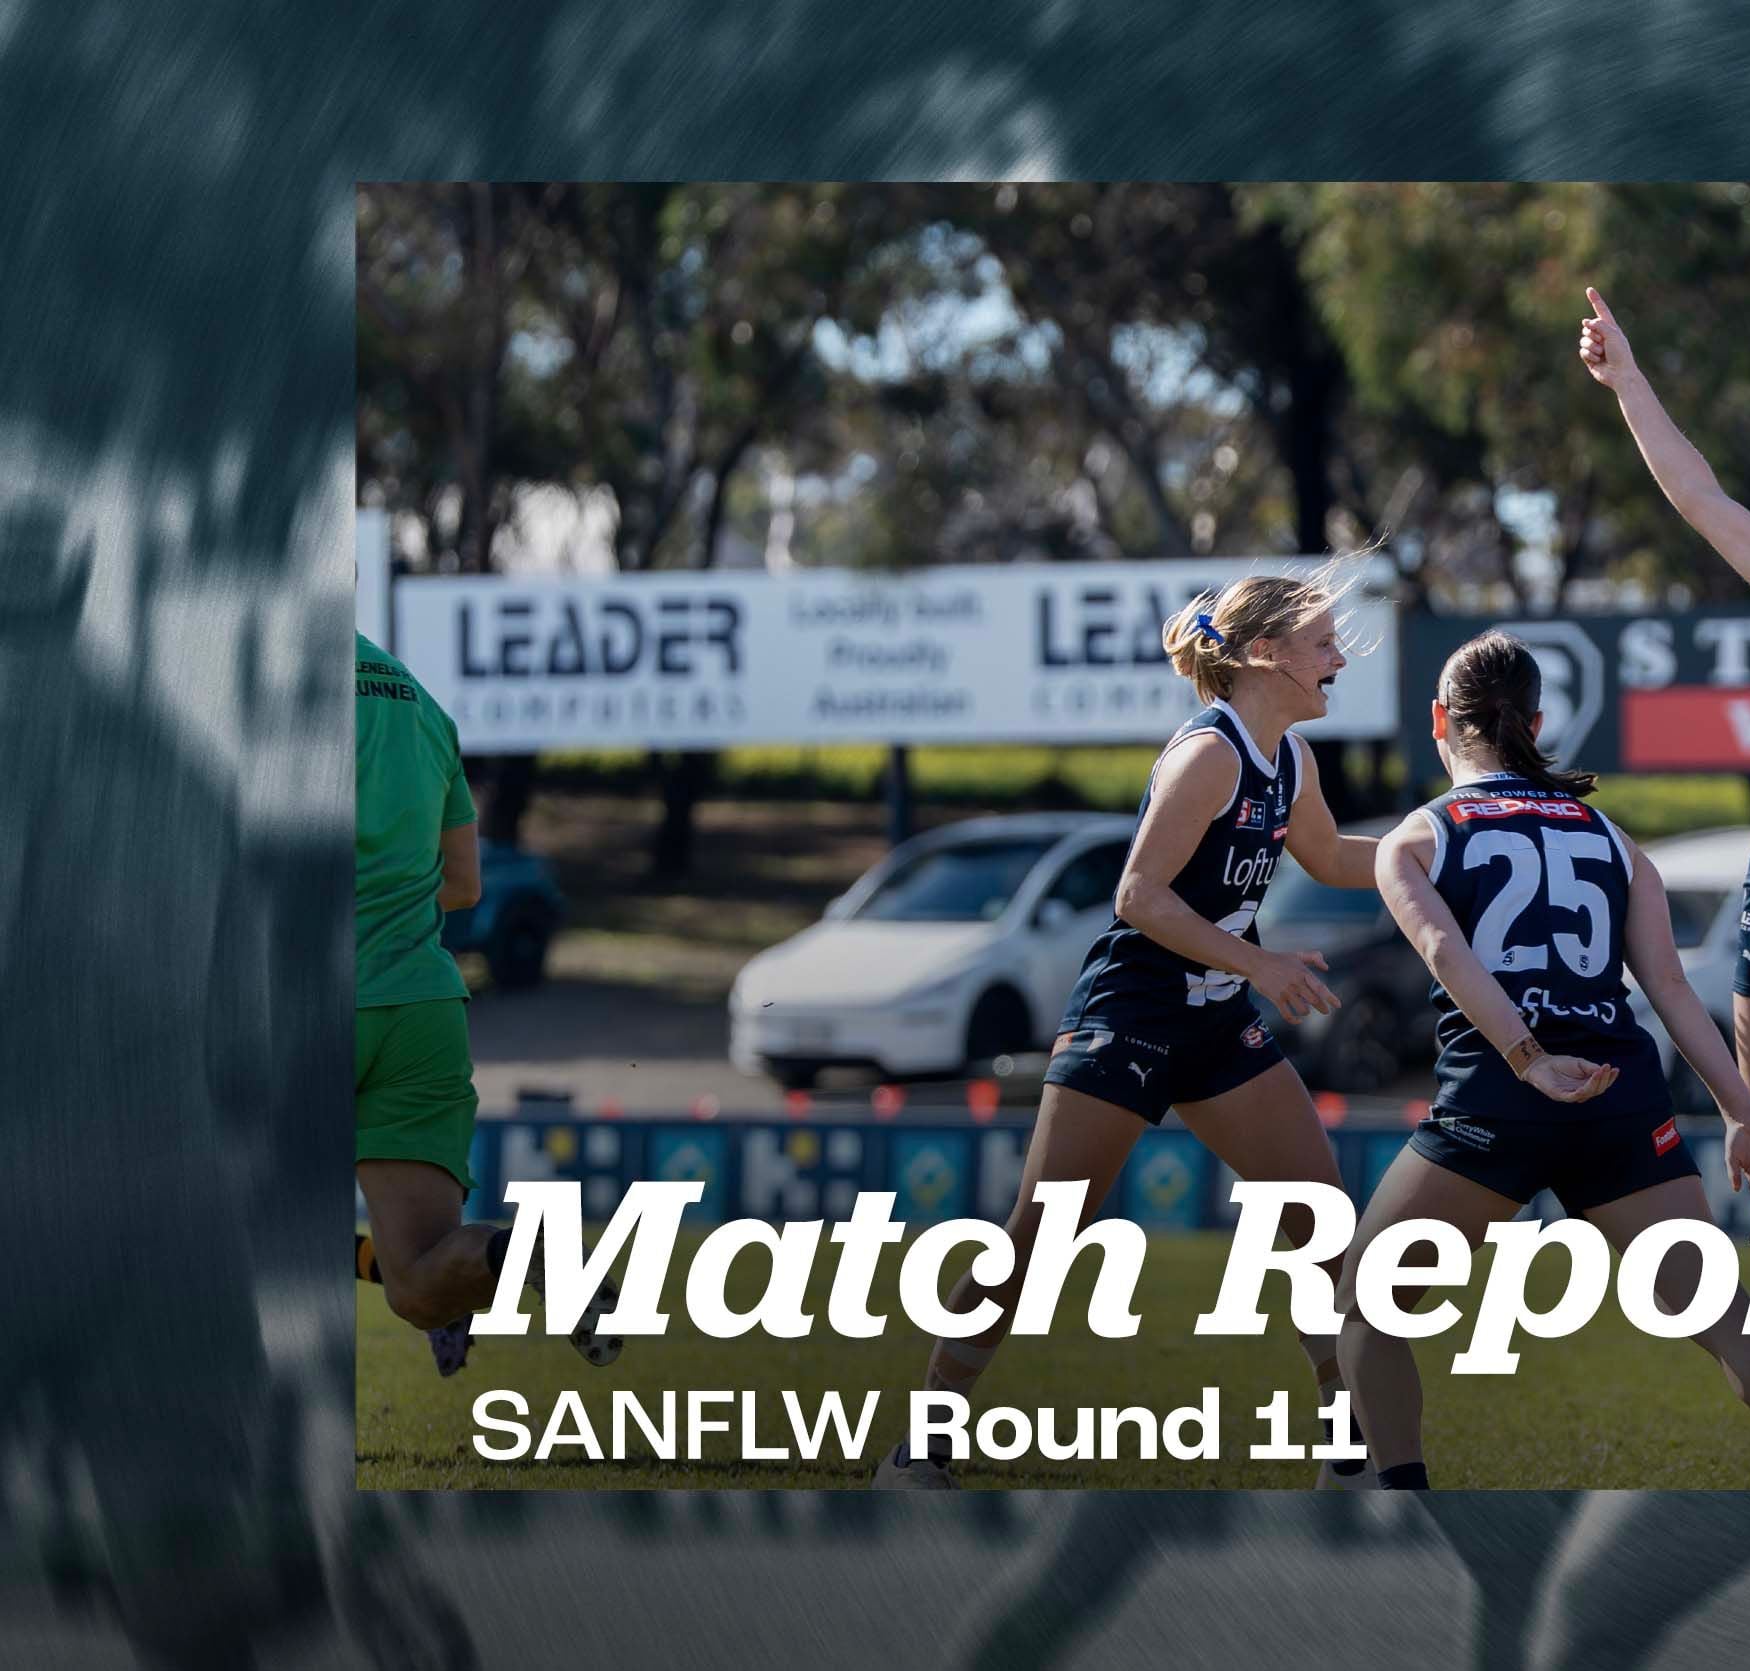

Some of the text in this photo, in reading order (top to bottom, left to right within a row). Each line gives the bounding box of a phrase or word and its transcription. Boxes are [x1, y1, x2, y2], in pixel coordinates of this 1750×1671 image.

[458, 596, 743, 678] LEADER
[1039, 586, 1215, 666] LEA
[1450, 791, 1482, 800] THE
[1489, 789, 1548, 799] POWER
[1456, 800, 1583, 818] REDARC
[1222, 845, 1281, 895] loftu
[1462, 826, 1613, 978] 25
